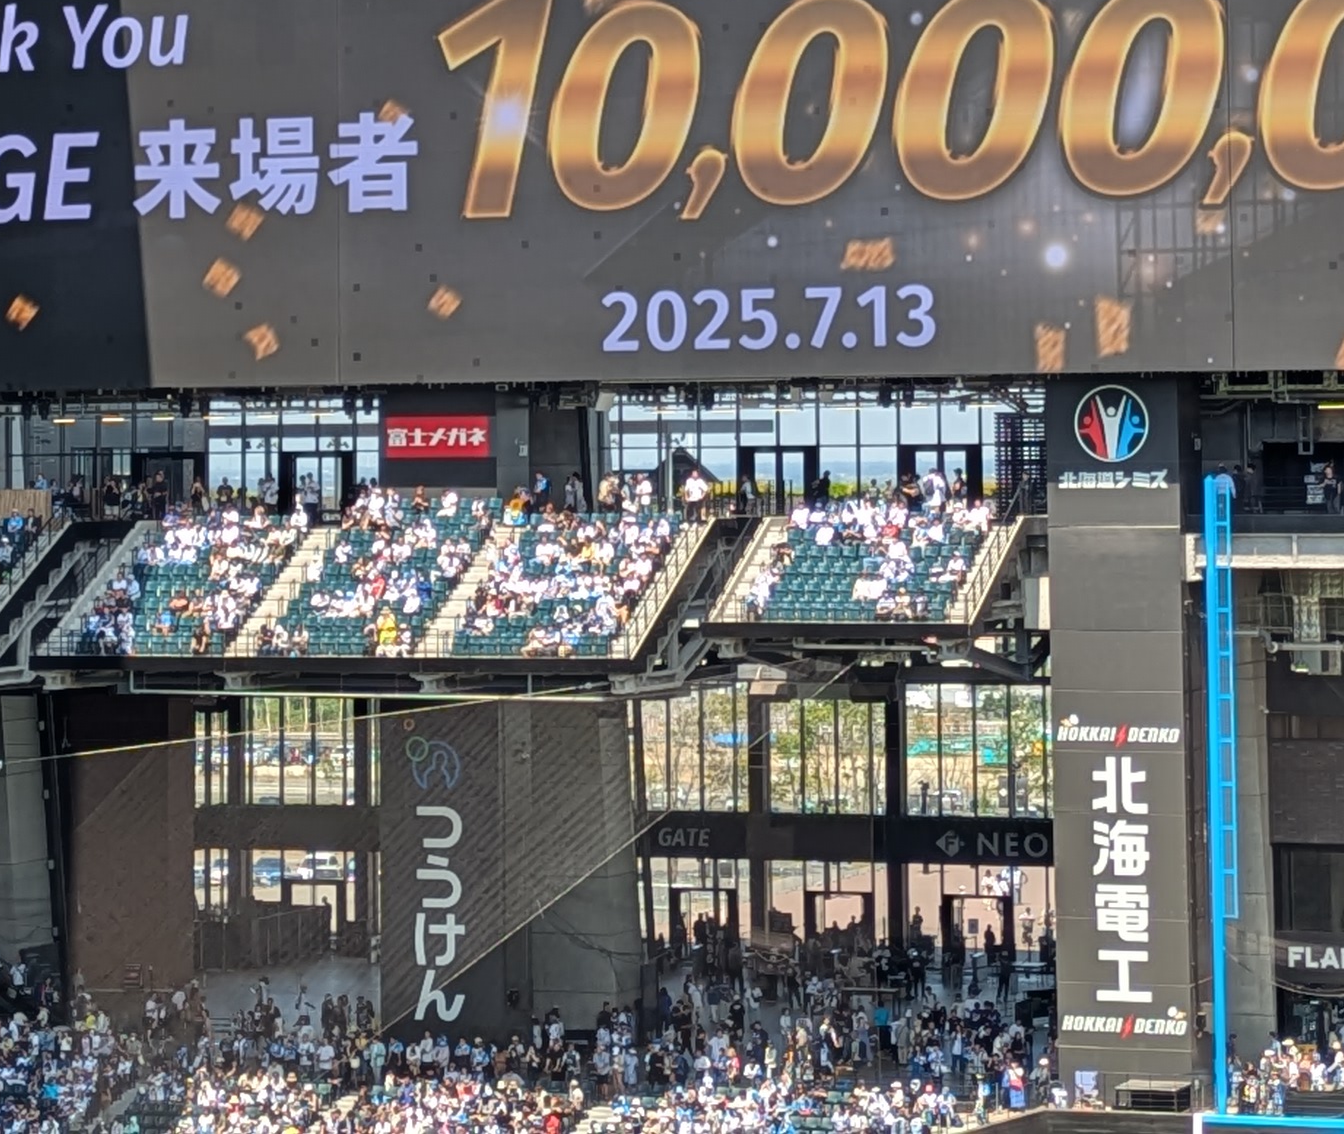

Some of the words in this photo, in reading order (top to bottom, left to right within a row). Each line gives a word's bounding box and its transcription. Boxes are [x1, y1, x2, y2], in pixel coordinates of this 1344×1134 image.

[63, 3, 189, 69] You
[133, 113, 418, 220] 来場者
[601, 284, 936, 352] 2025.7.13
[387, 428, 487, 447] 富士メガネ
[1058, 469, 1169, 489] 北海道シミズ
[1057, 725, 1118, 743] HOKKAI
[1128, 726, 1180, 744] DENKO
[658, 827, 711, 849] GATE
[977, 832, 1048, 858] NEO
[1091, 756, 1152, 1003] 北海電工
[414, 806, 465, 1022] つうけん
[1062, 1015, 1124, 1034] HOKKAI
[1134, 1018, 1187, 1036] DENKO
